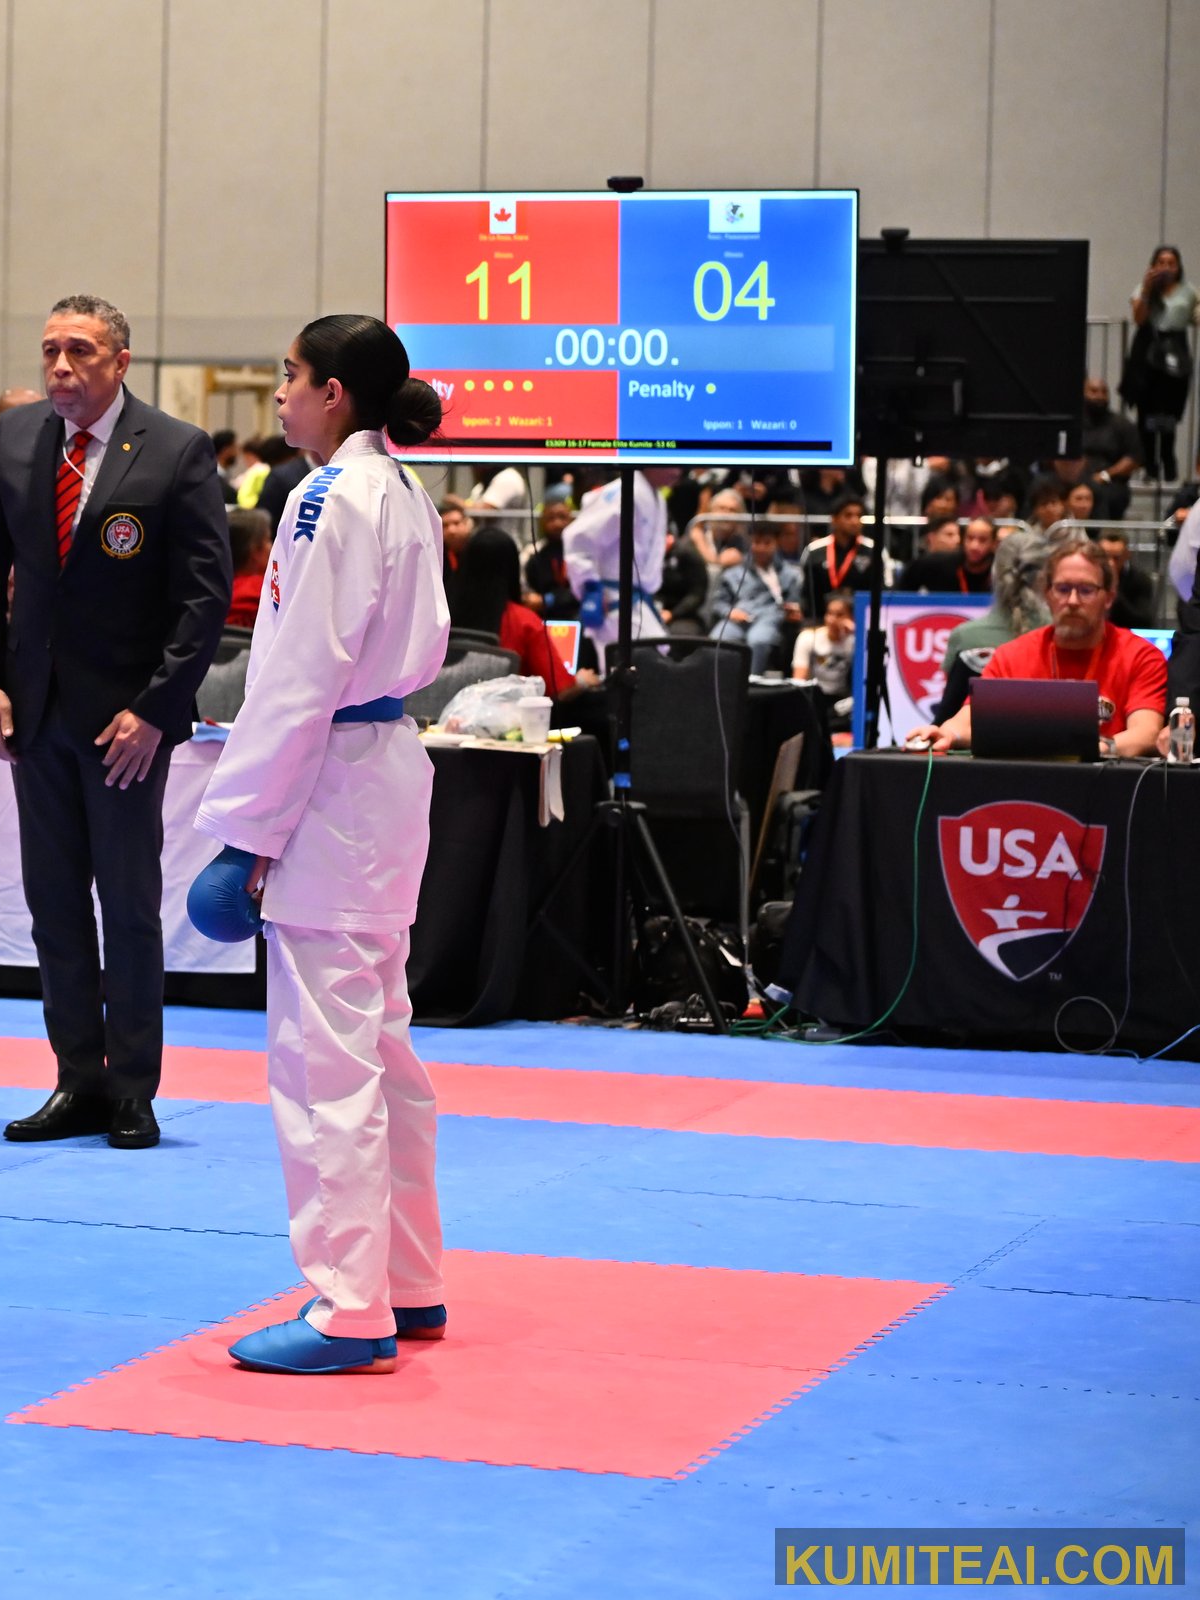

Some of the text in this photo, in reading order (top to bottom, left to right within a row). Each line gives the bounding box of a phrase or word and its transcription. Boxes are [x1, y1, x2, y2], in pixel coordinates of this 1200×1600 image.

[465, 261, 531, 321] 11
[693, 260, 776, 321] 04
[628, 379, 696, 402] Penalty
[115, 524, 130, 534] USA
[293, 465, 344, 543] PUNOK
[905, 626, 951, 664] US
[958, 825, 1083, 881] USA
